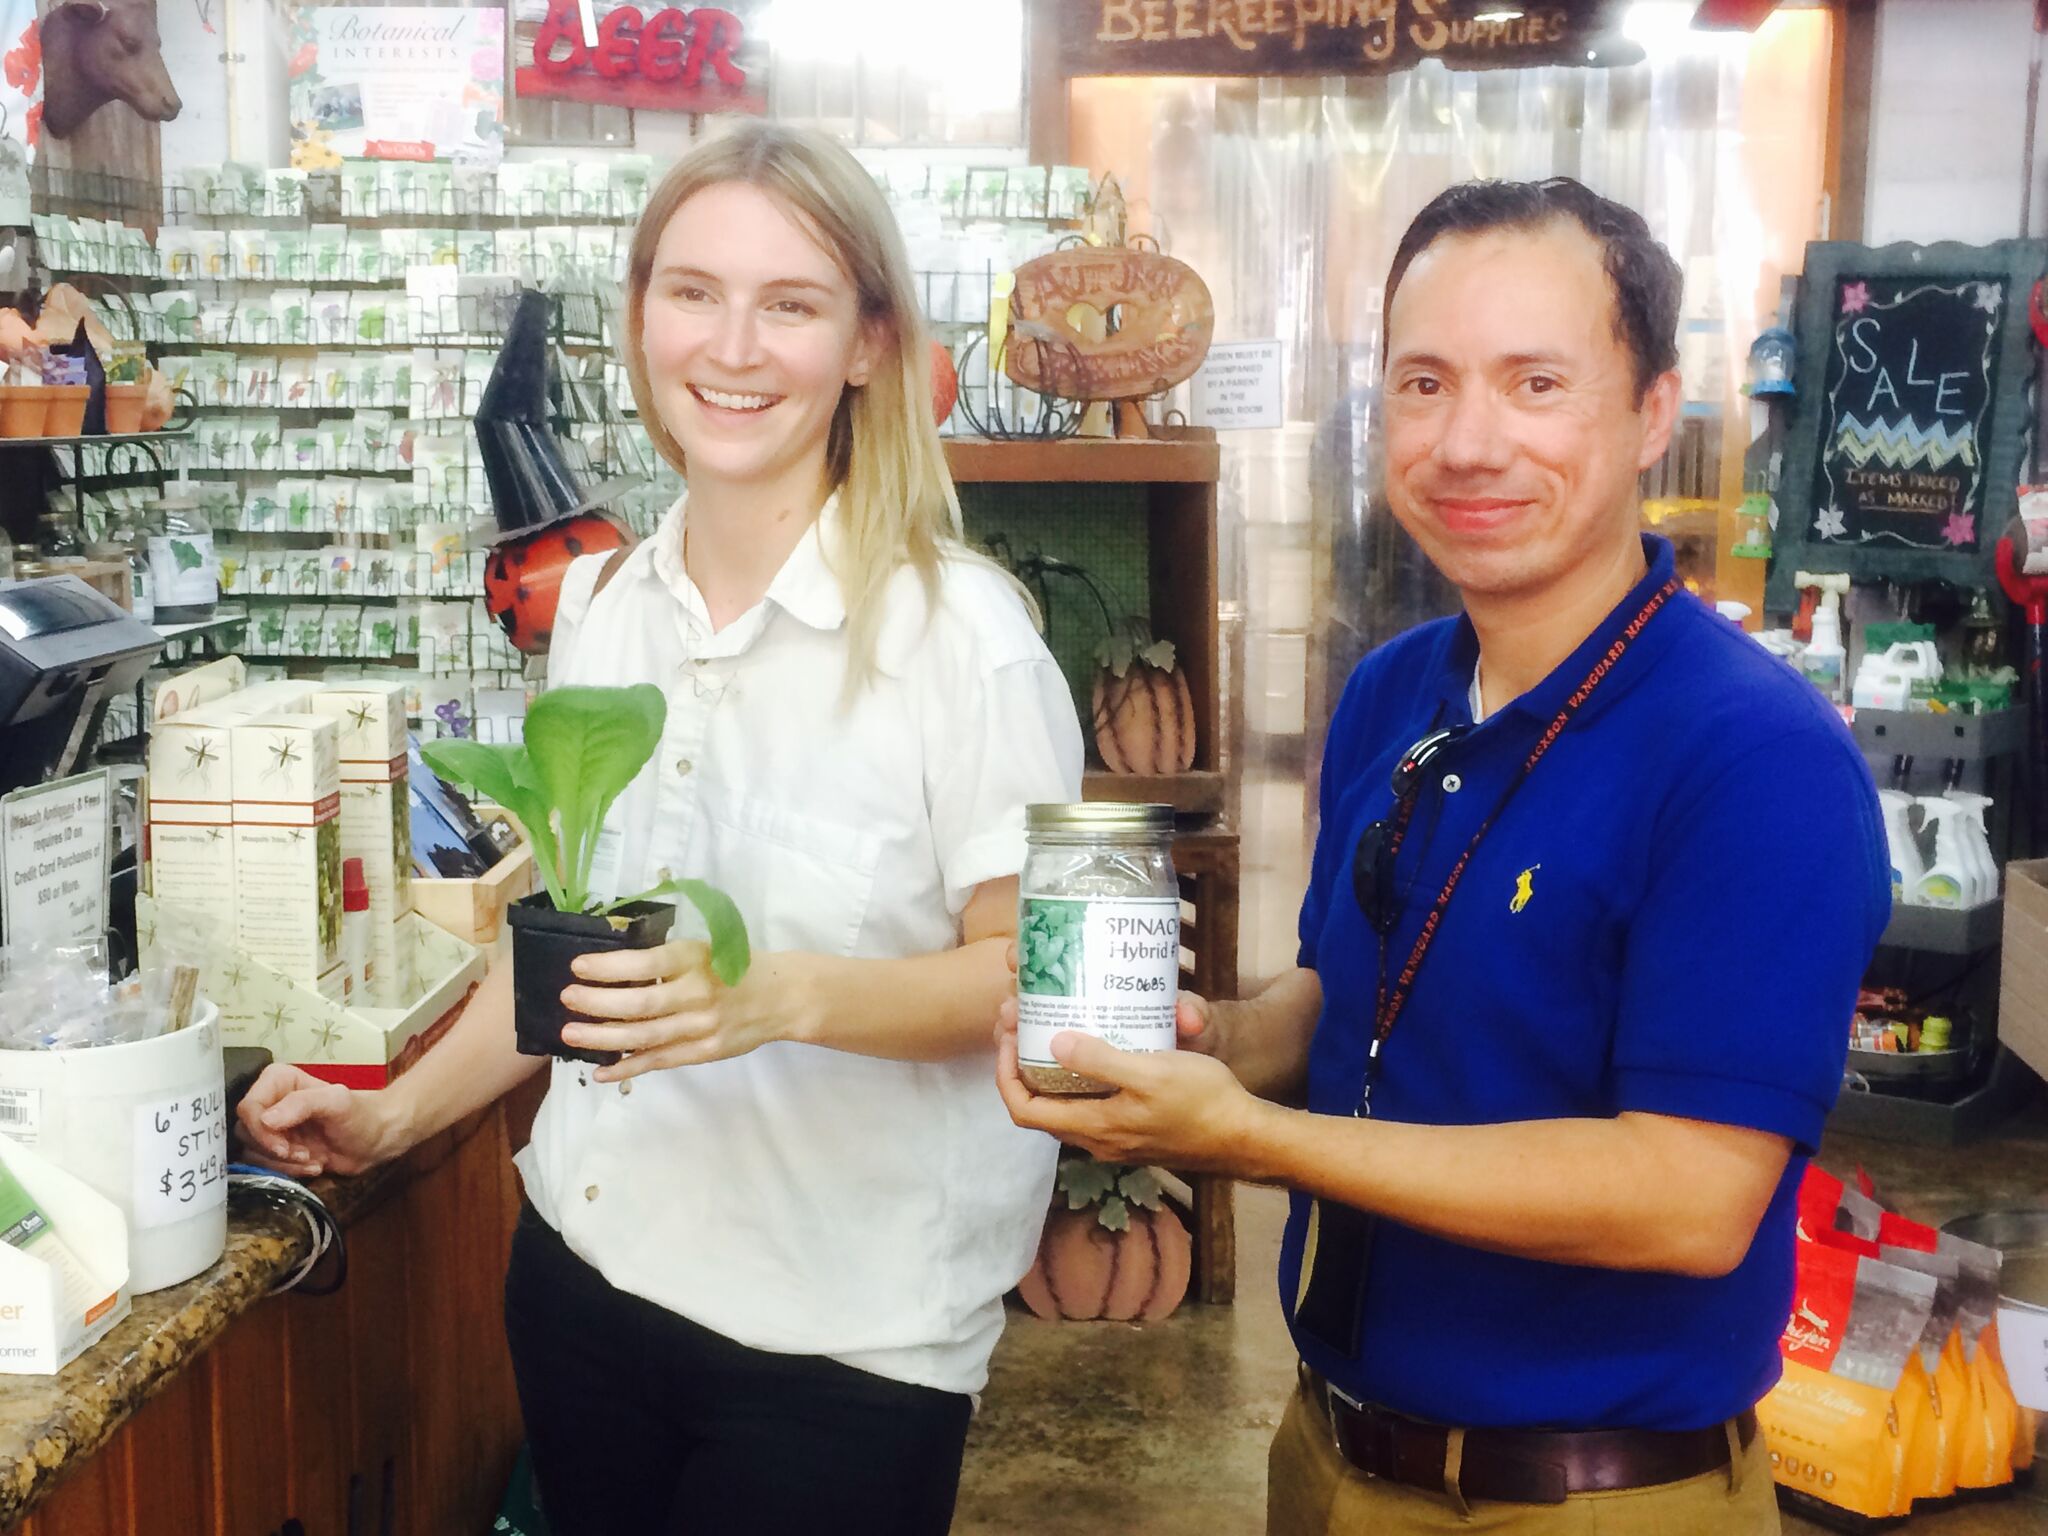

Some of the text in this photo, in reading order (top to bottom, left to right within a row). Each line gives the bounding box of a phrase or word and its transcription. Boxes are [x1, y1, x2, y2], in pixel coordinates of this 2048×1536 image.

[328, 14, 466, 42] Botanical
[1409, 0, 1568, 50] SUPPLIES
[333, 46, 459, 60] INTERESTS
[1849, 317, 1971, 416] SALE
[1568, 640, 1626, 709] VANGUARD
[14, 864, 37, 886] Credit
[38, 859, 56, 878] Card
[1109, 941, 1168, 963] Hybrid
[155, 1088, 224, 1133] 6" BUL
